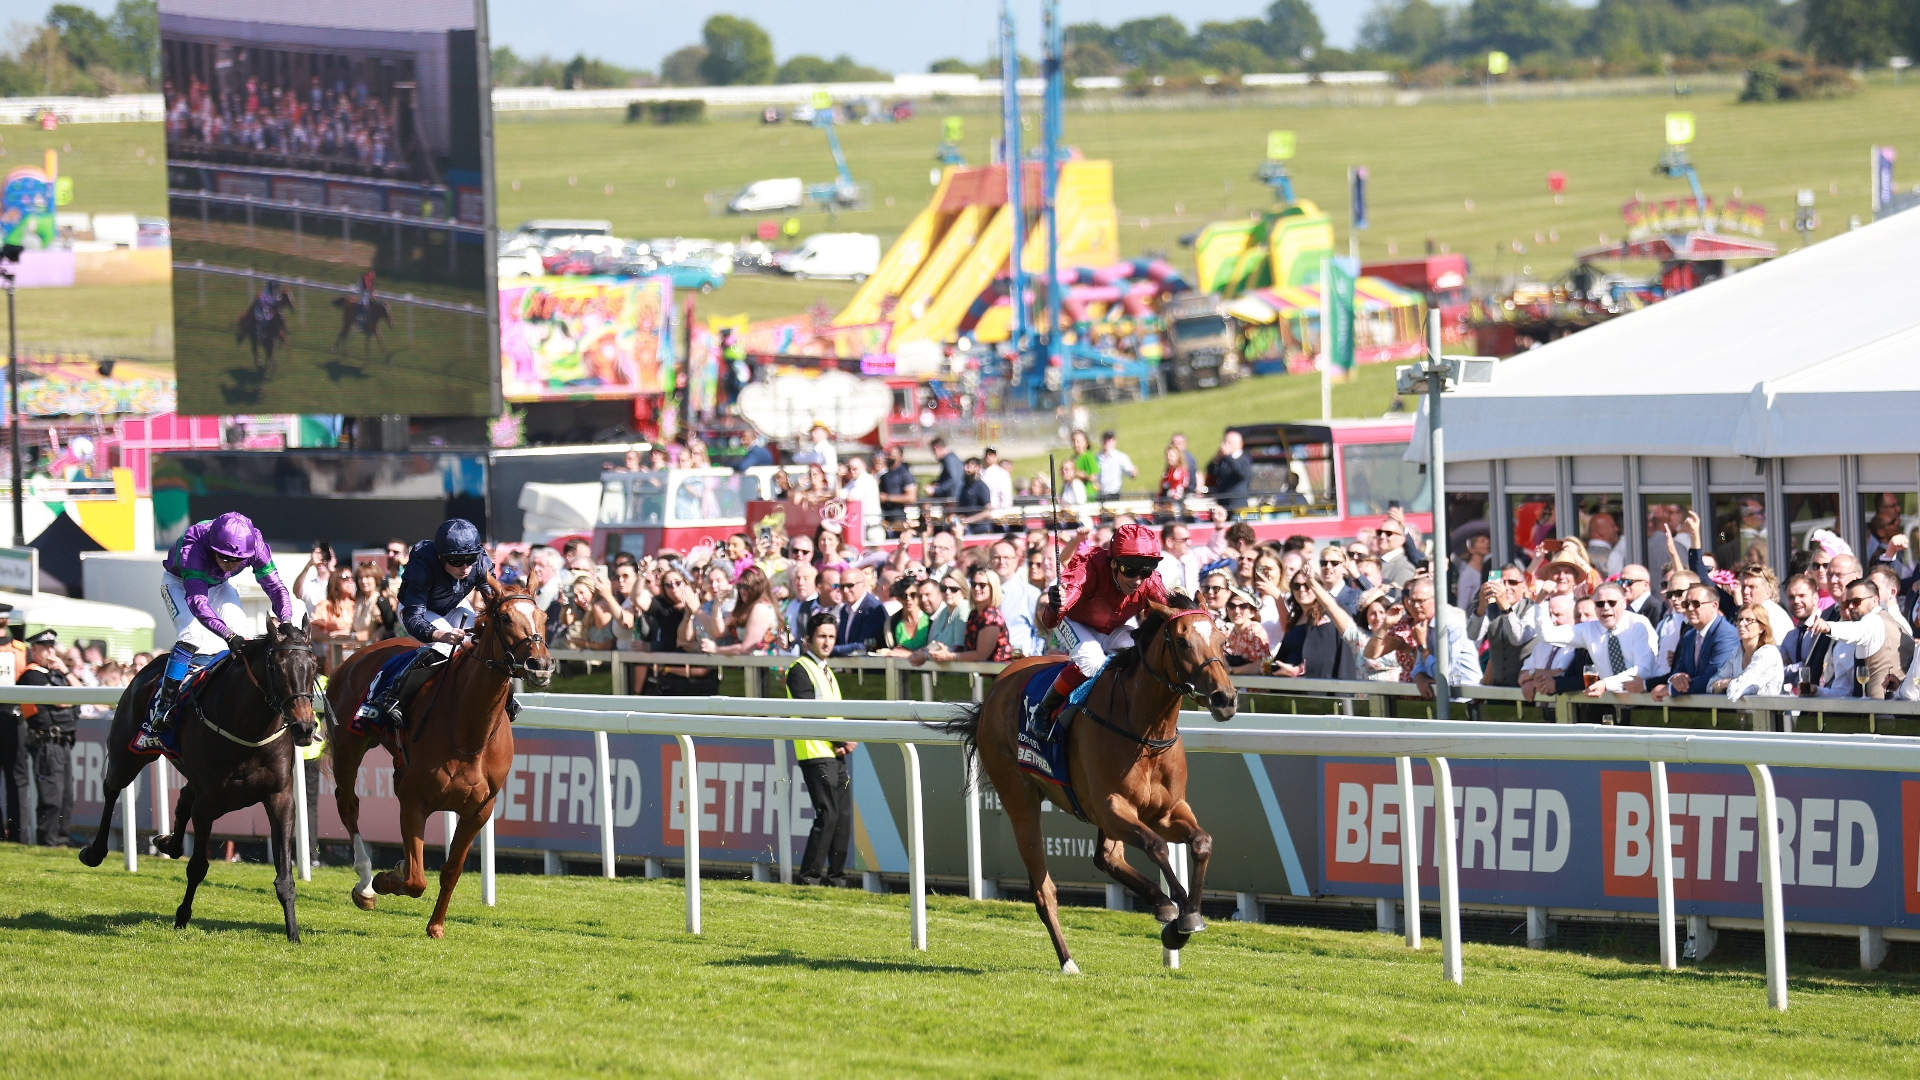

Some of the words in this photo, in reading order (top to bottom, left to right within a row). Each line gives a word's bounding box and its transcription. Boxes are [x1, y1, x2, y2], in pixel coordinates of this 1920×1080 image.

[669, 760, 817, 837] BETFRE
[1042, 837, 1095, 857] ESTIVA
[1614, 791, 1879, 889] BETFRED
